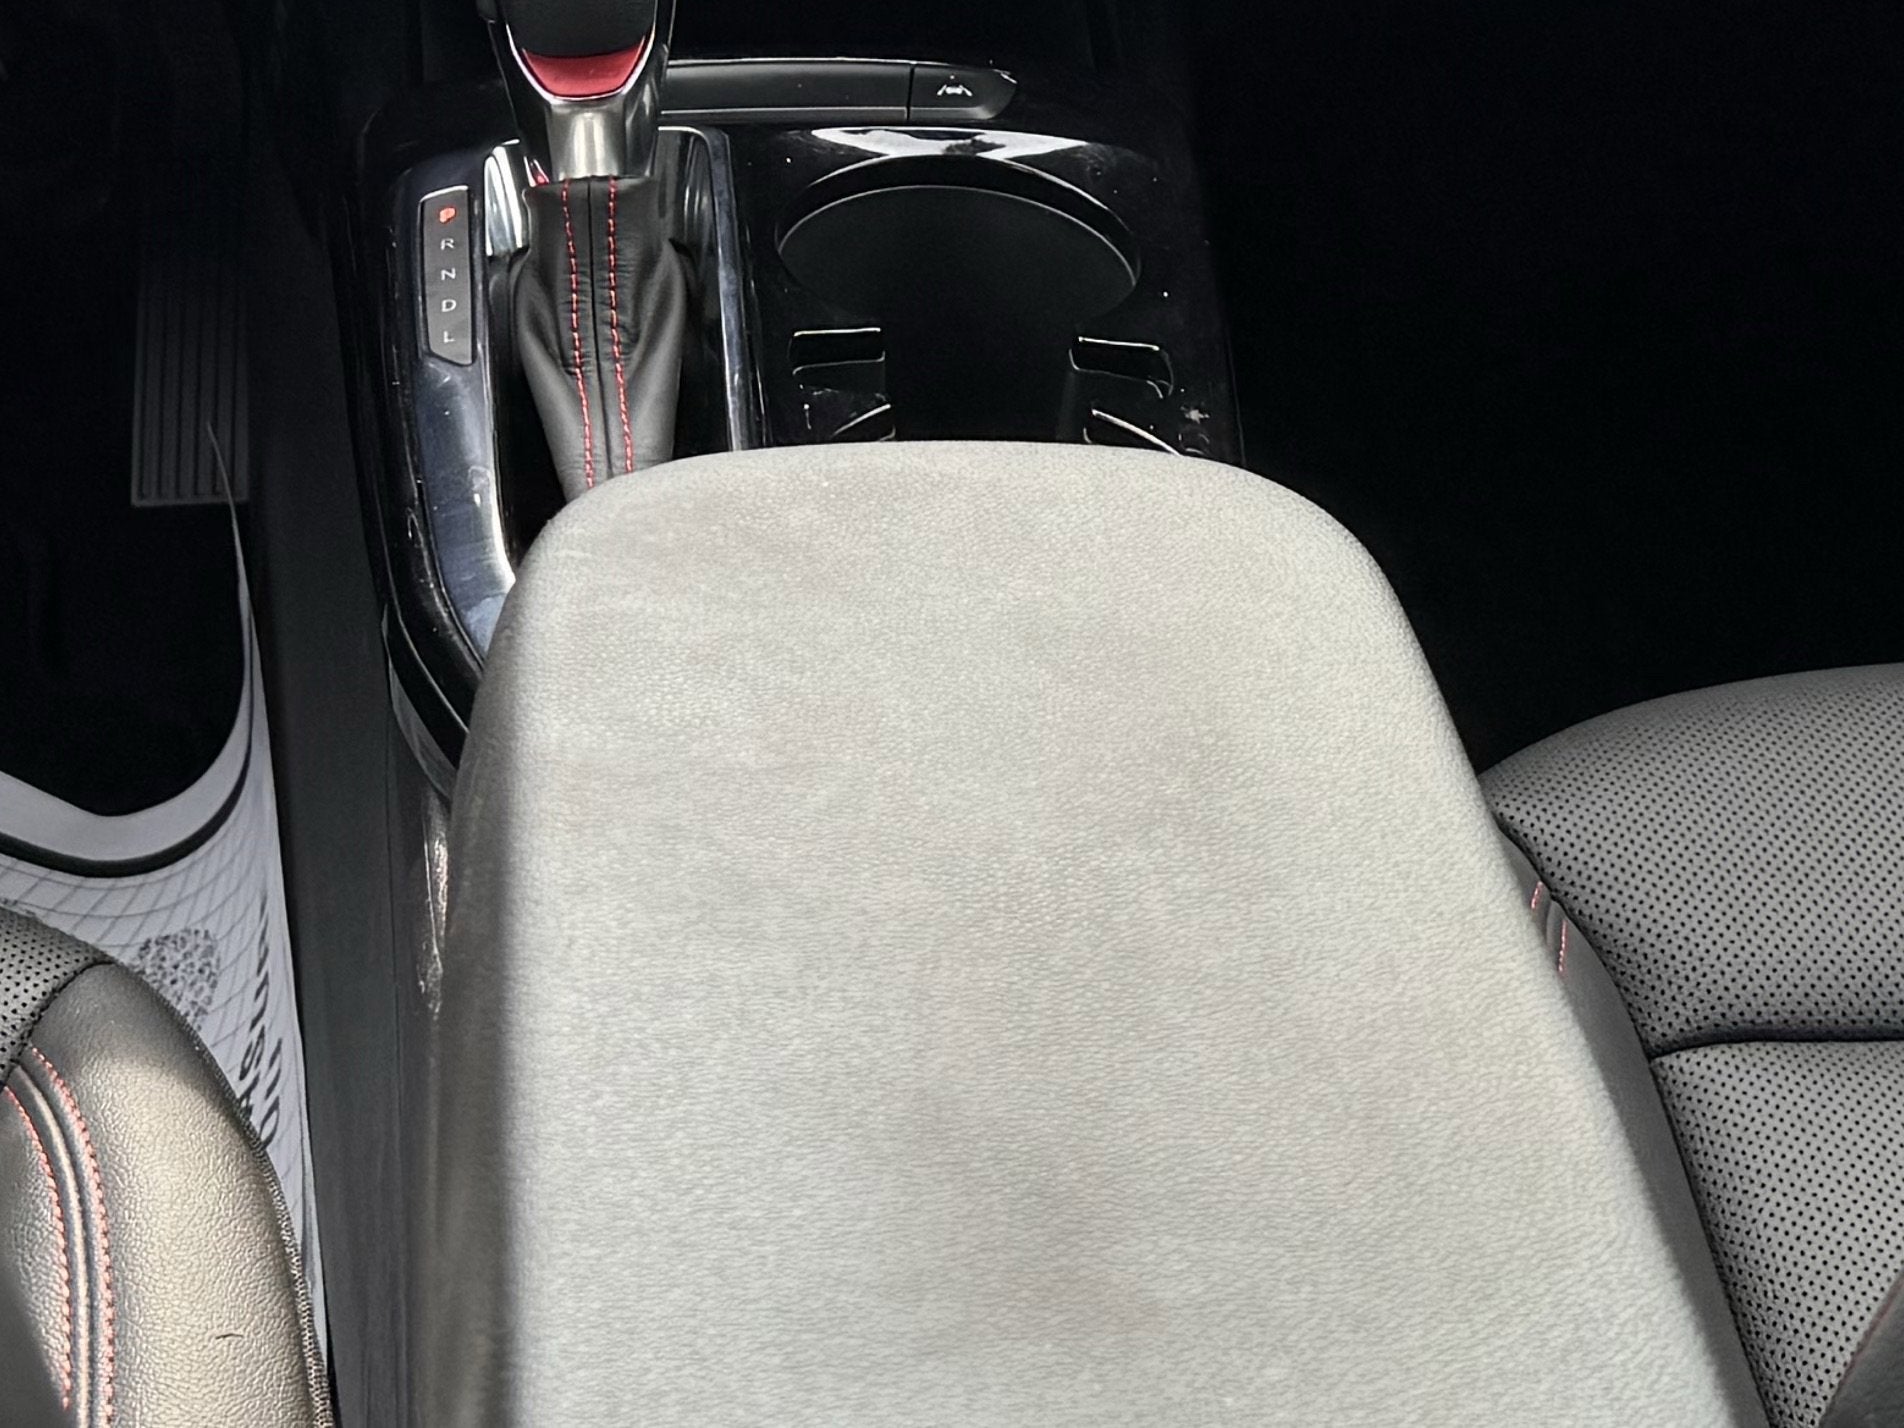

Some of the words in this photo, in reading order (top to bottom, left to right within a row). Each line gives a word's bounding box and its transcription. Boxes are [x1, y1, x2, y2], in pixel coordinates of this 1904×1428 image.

[440, 237, 456, 251] R
[440, 267, 457, 281] N
[441, 298, 458, 313] D
[443, 329, 457, 345] L
